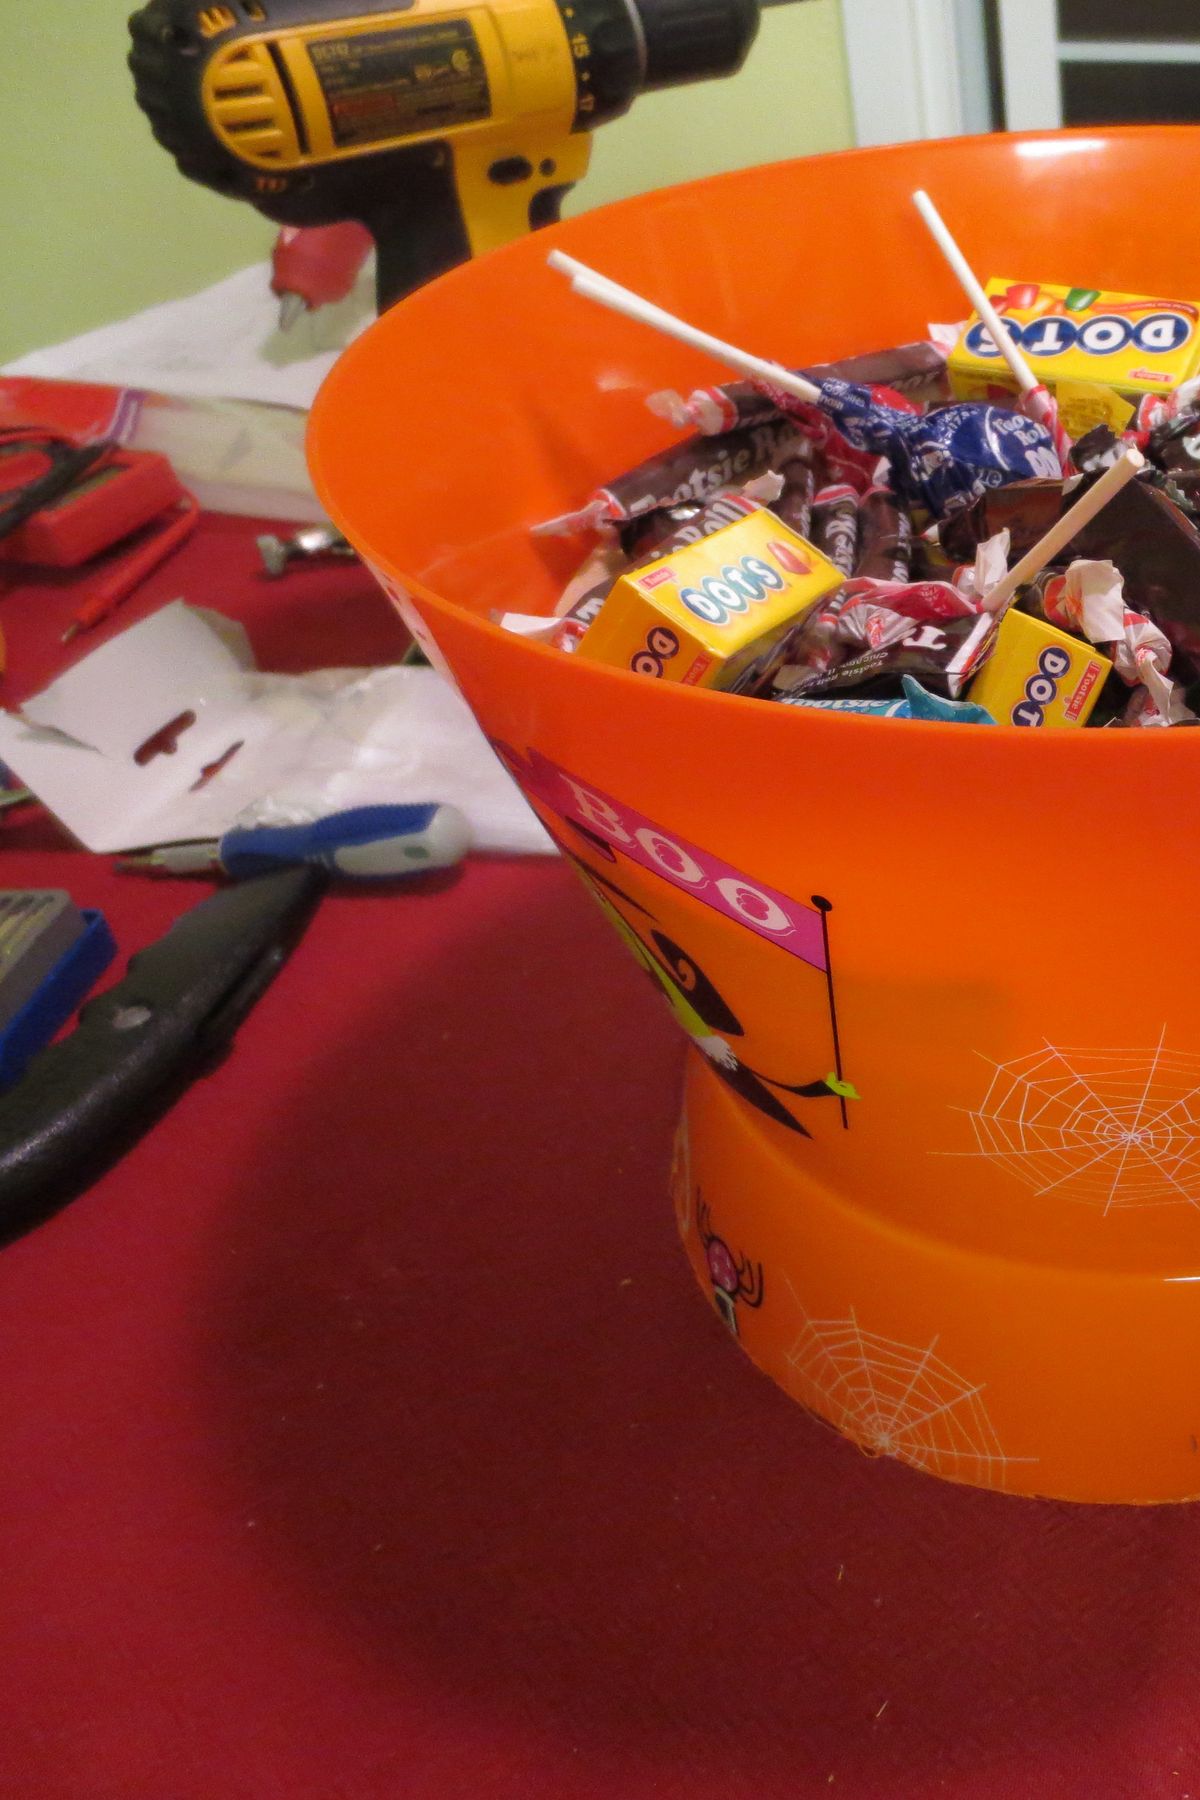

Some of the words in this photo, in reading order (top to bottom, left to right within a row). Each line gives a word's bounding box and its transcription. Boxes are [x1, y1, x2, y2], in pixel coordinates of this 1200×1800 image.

[683, 556, 781, 621] DOTS
[1015, 650, 1070, 727] DOT
[1071, 672, 1096, 710] Tootsie
[559, 772, 797, 936] BOO
